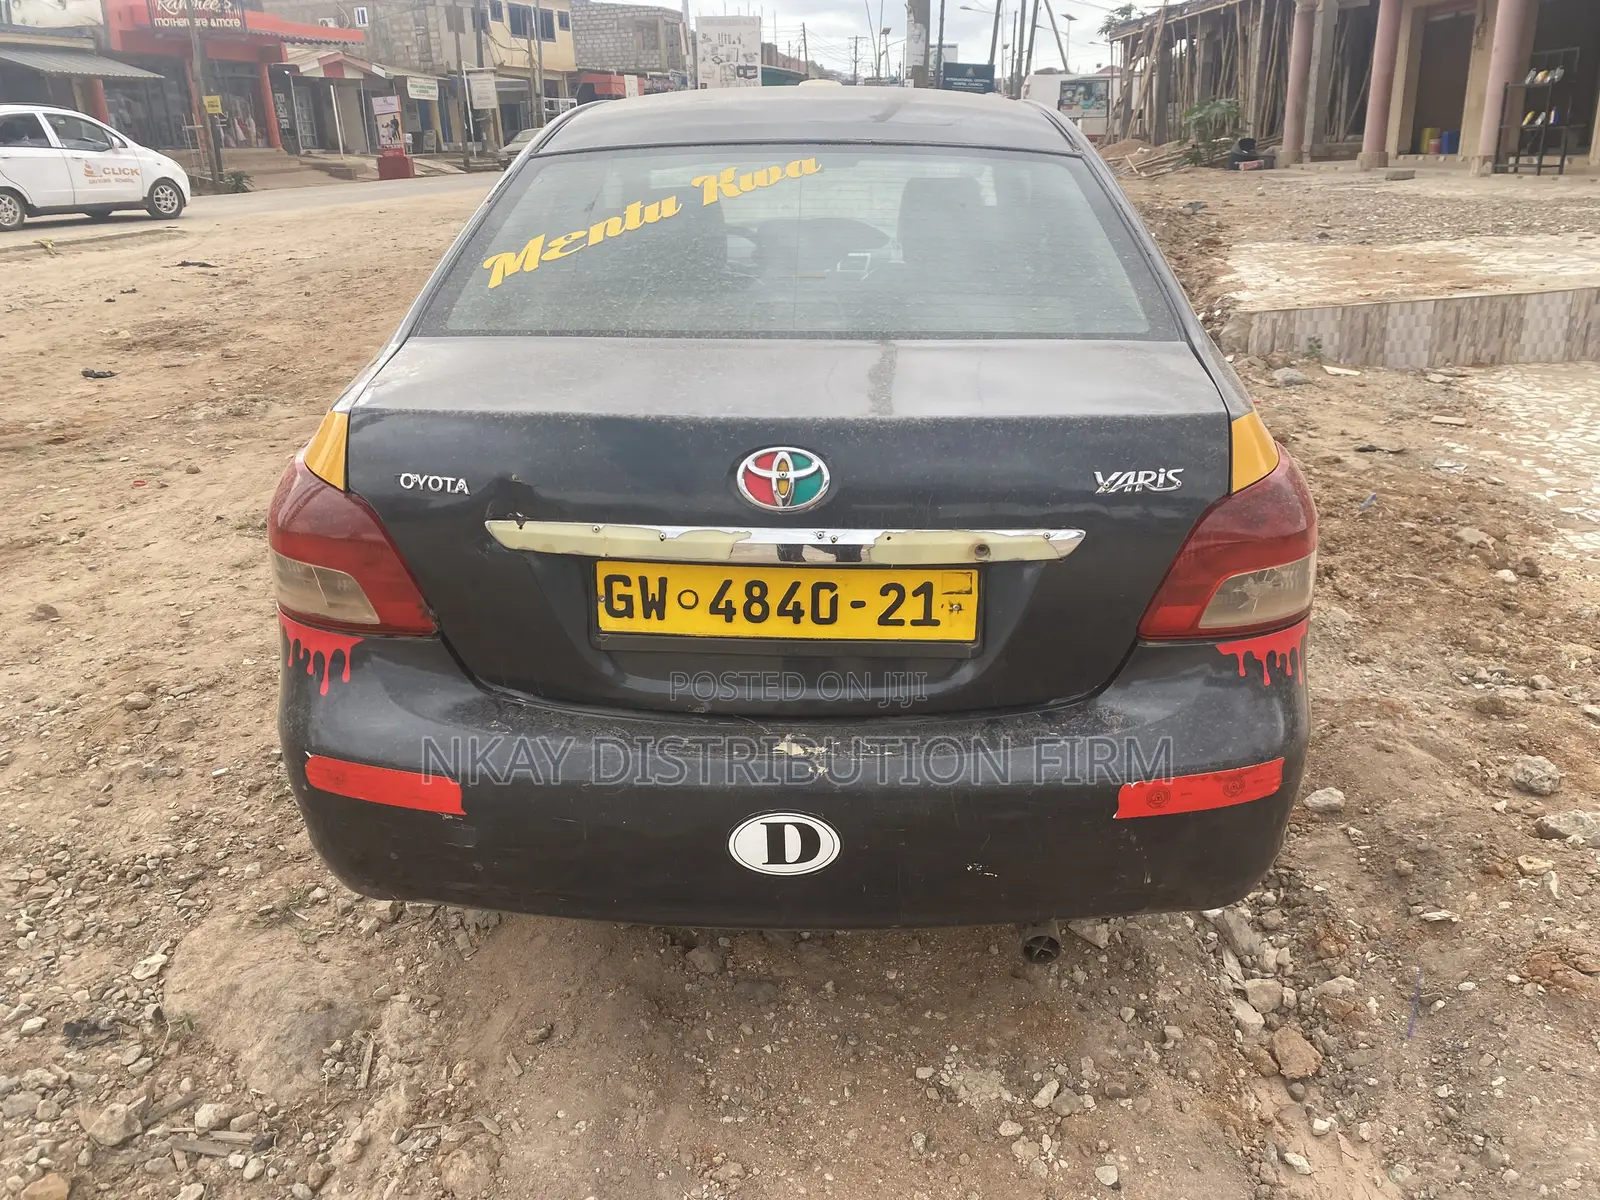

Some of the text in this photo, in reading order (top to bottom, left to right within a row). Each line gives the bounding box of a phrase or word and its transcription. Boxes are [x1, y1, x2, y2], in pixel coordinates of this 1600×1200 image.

[102, 167, 140, 175] CLICK
[691, 157, 822, 206] Kwa
[603, 574, 668, 621] GW
[760, 822, 821, 865] D
